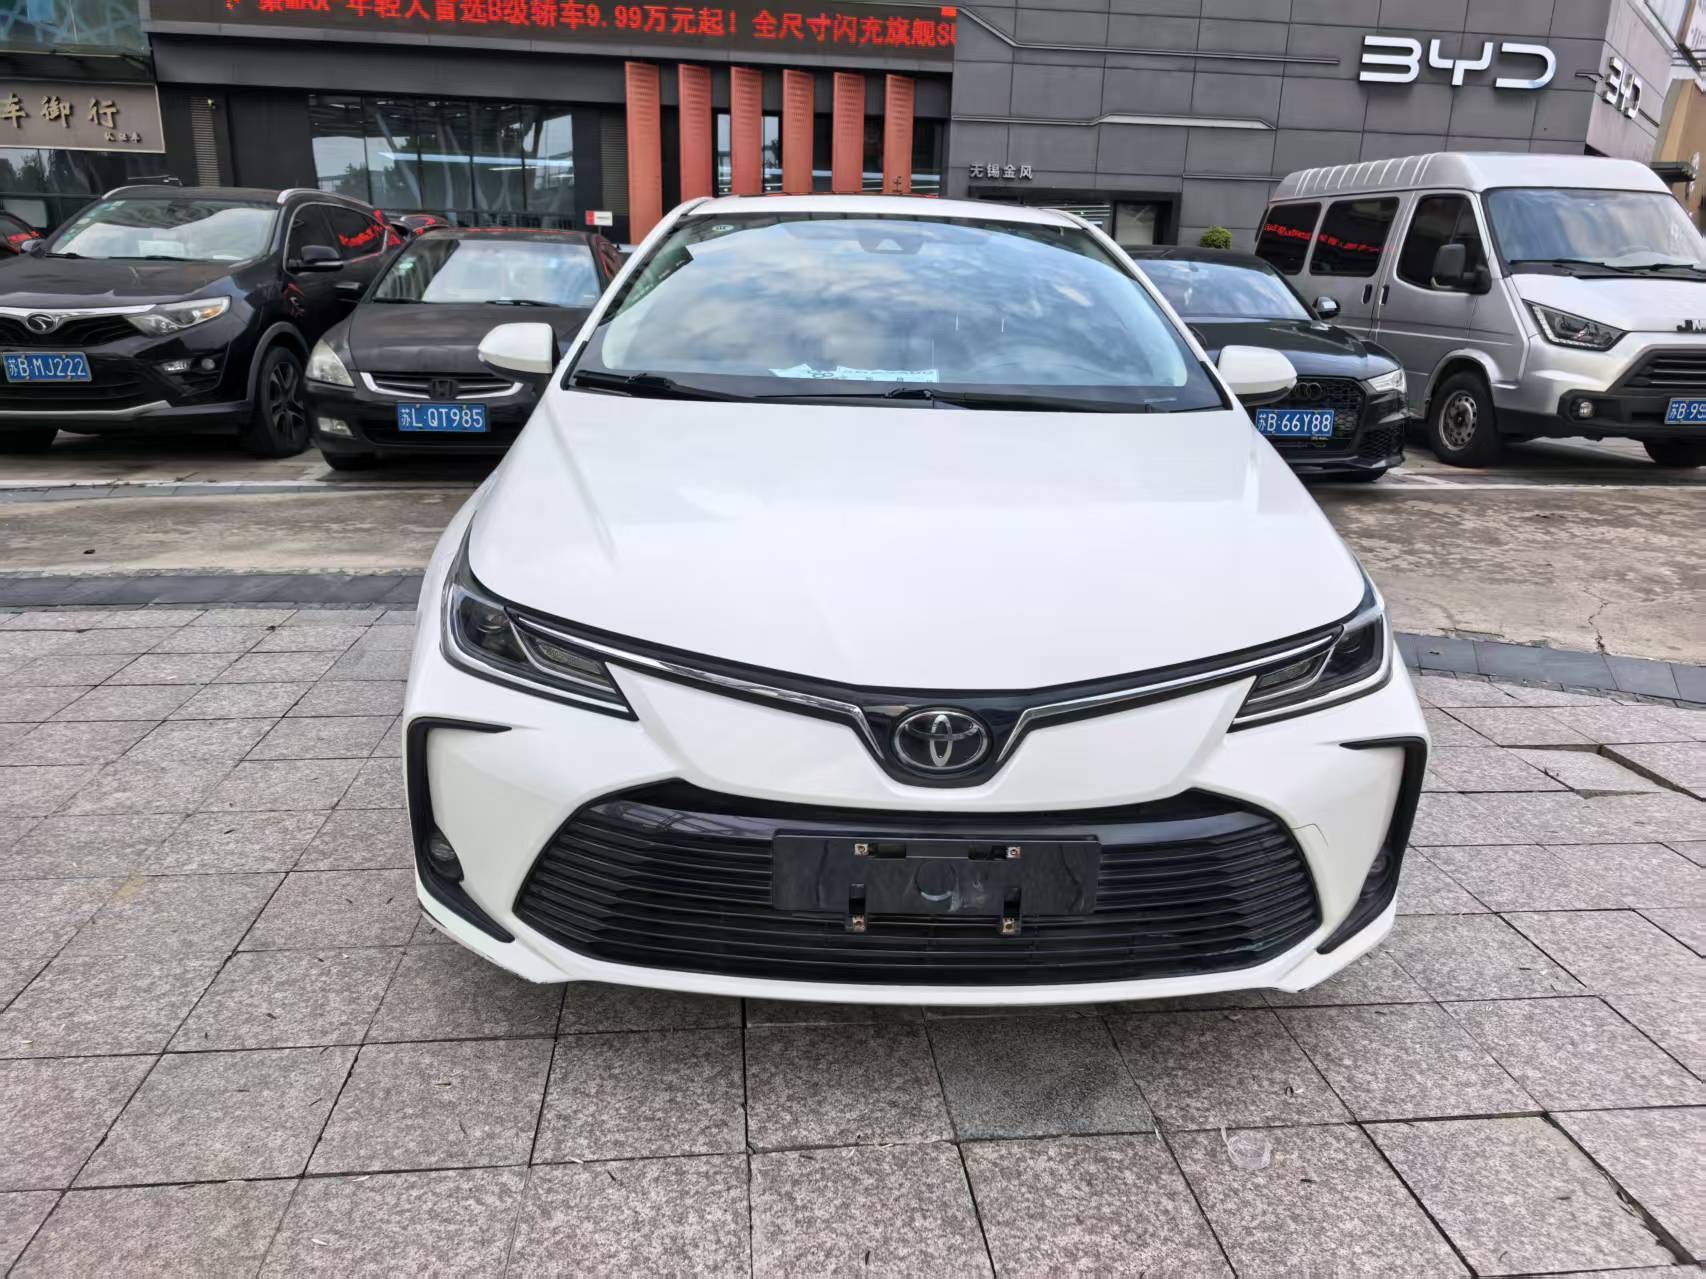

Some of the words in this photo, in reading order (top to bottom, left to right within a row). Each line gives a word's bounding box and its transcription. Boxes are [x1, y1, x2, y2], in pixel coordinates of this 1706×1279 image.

[1359, 35, 1557, 89] BYD
[969, 162, 1033, 180] 无锡金风
[399, 407, 484, 428] 苏L·QT985
[1257, 412, 1332, 433] 苏B·66Y88
